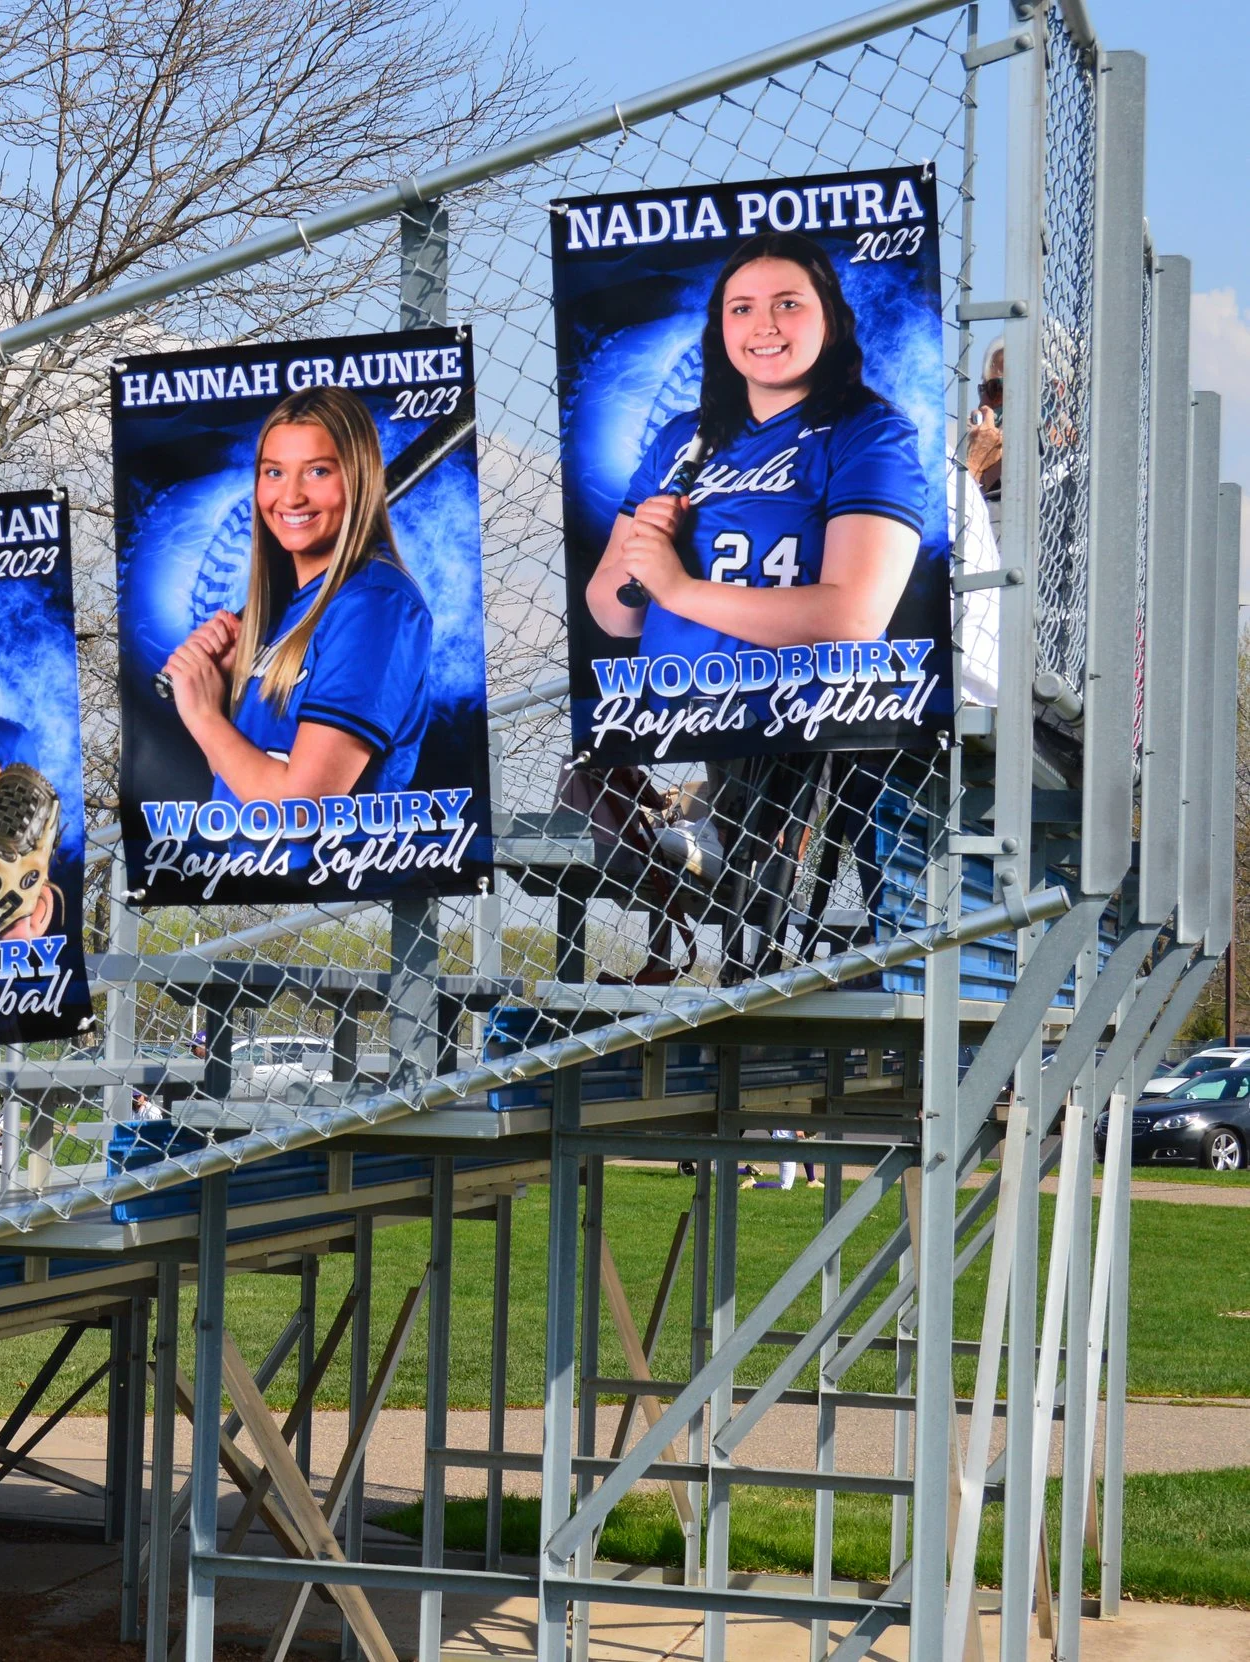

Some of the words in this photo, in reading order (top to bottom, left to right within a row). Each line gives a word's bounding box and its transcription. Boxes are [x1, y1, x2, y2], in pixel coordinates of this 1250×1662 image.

[567, 197, 726, 251] NADIA
[737, 180, 924, 236] POITRA
[850, 225, 925, 265] 2023
[121, 361, 278, 408] HANNAH
[286, 347, 462, 392] GRAUNKE
[389, 385, 462, 422] 2023
[711, 533, 799, 588] 24
[592, 638, 934, 698] WOODBURY
[592, 684, 747, 759] Royals
[764, 674, 940, 743] Softball
[141, 787, 472, 844] WOODBURY
[143, 827, 290, 900] Royals
[309, 821, 478, 891] Softball
